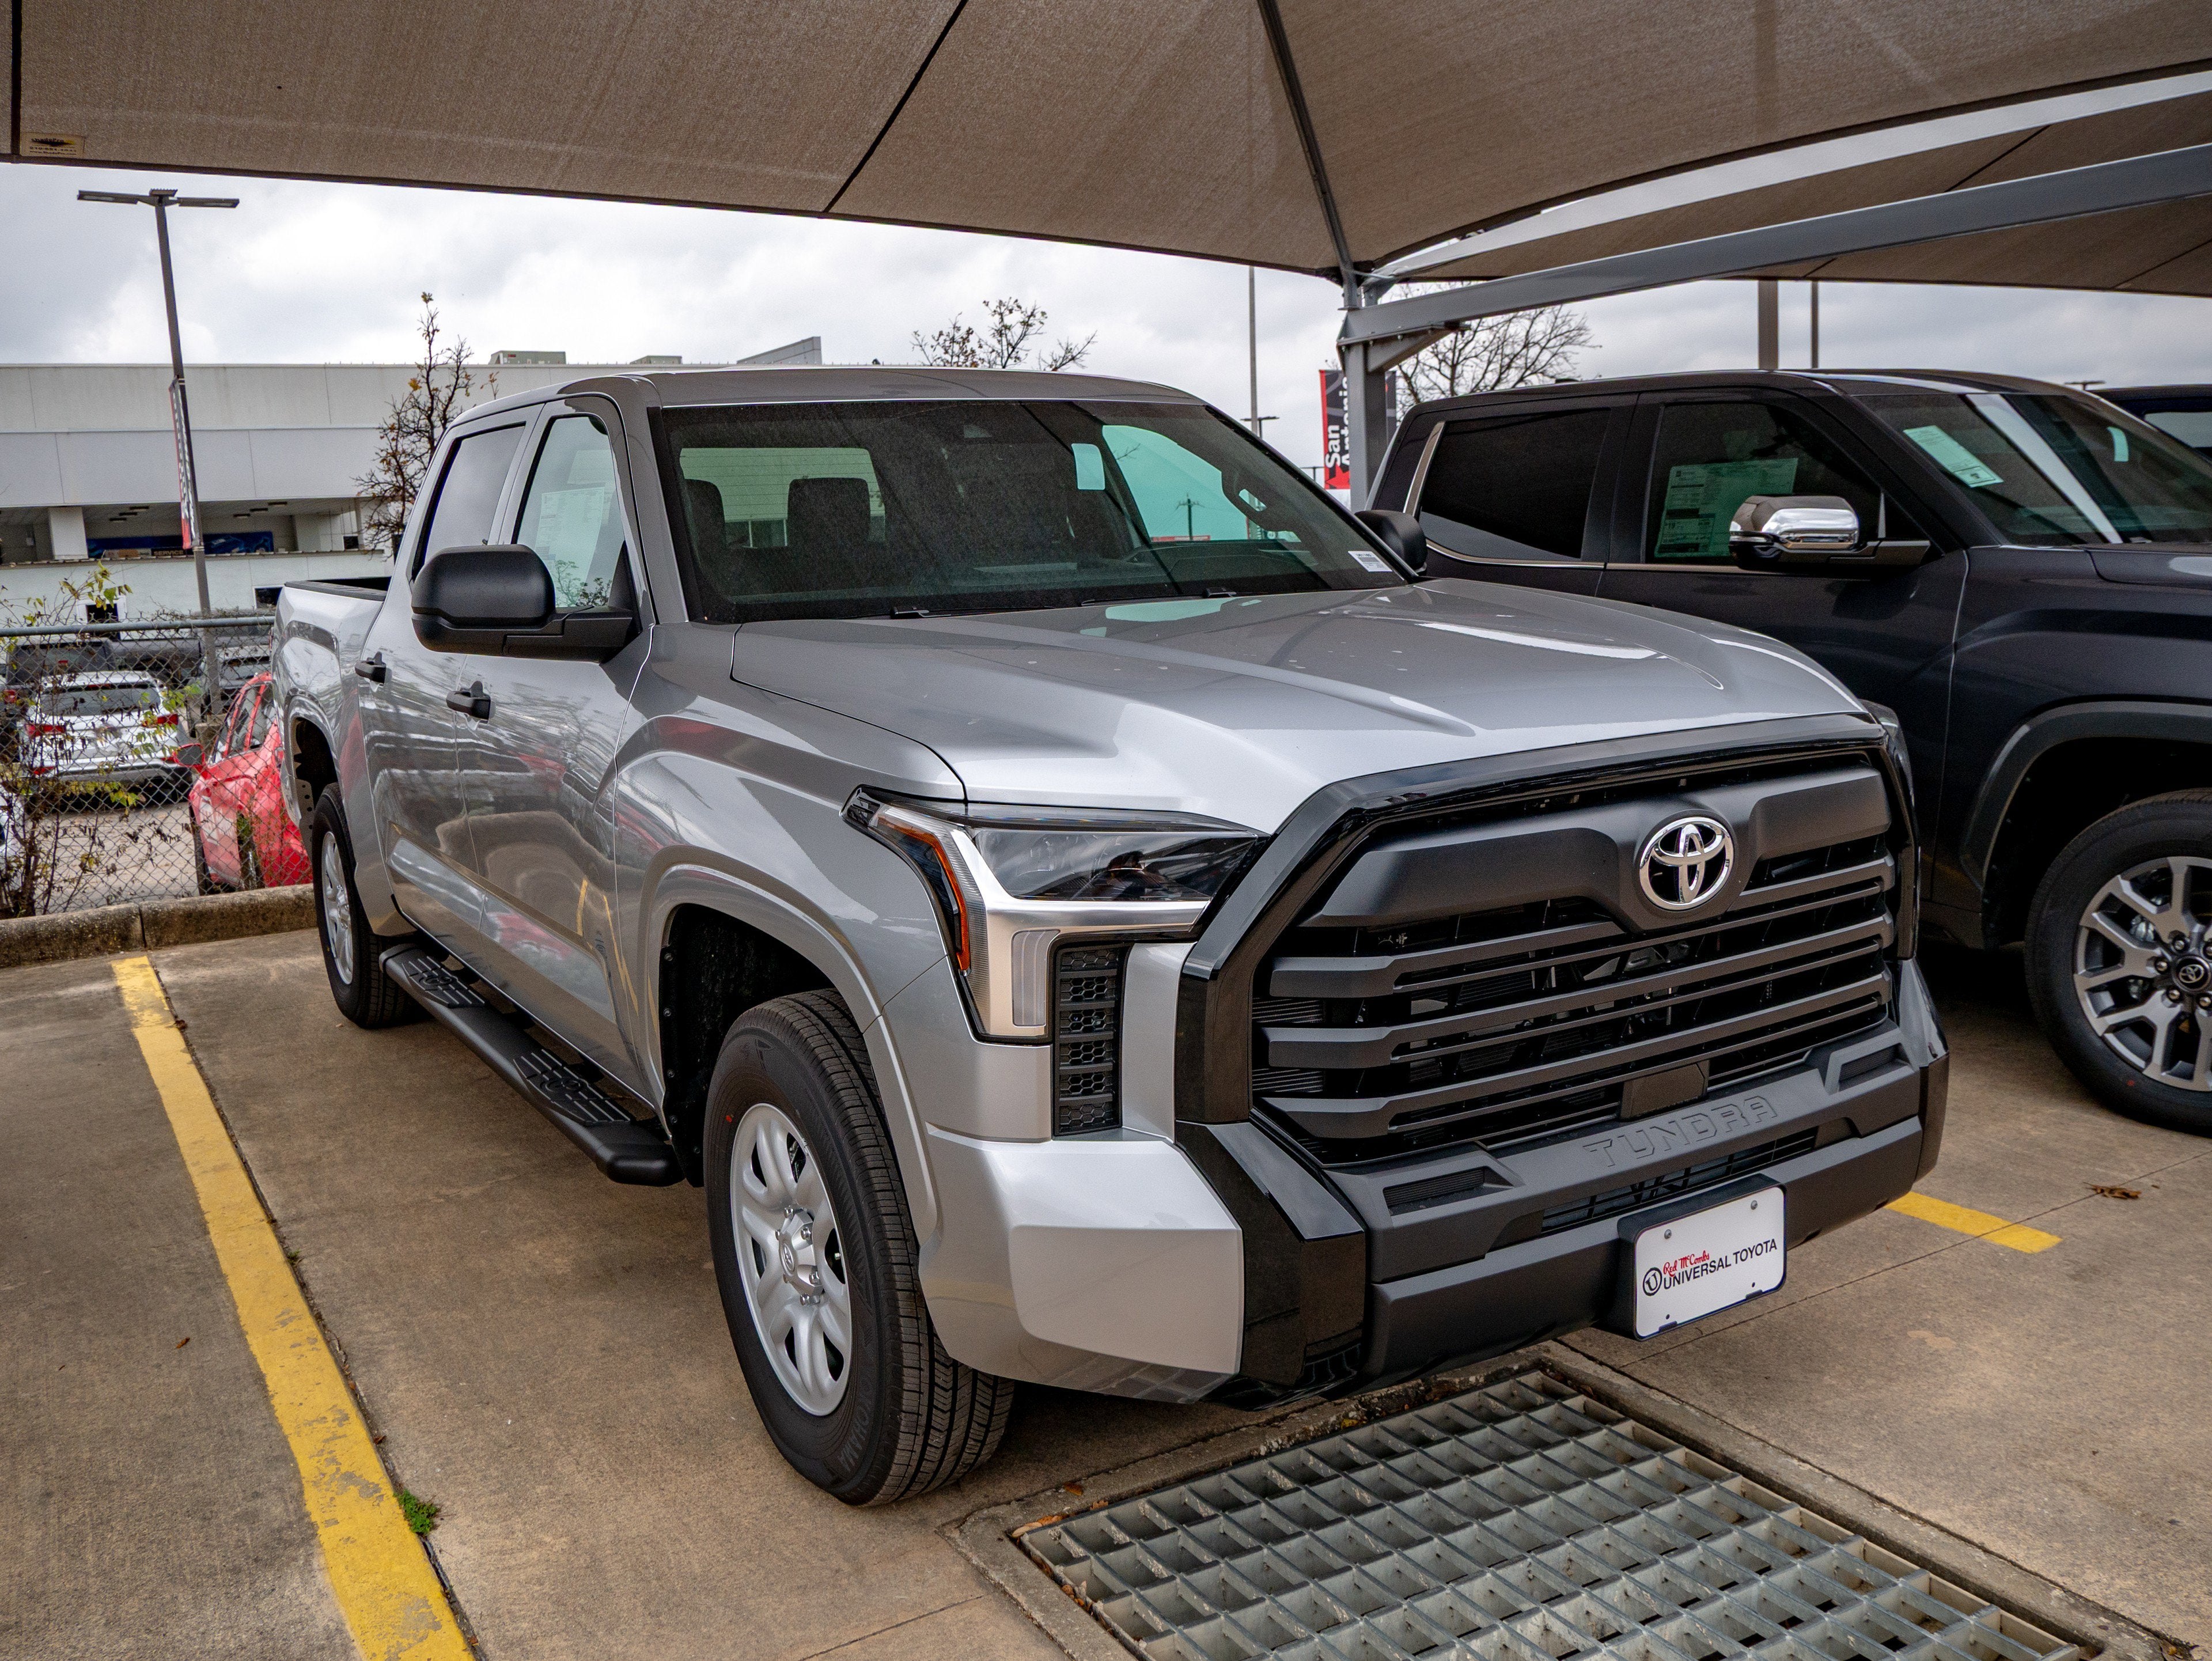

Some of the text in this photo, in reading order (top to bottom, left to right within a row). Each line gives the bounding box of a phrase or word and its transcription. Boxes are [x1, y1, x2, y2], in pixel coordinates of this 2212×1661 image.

[1325, 425, 1340, 468] San
[1582, 1095, 1778, 1167] TUNDRA
[1663, 1250, 1710, 1277] Red McCombs
[1664, 1255, 1732, 1289] UNIVERSAL
[1733, 1238, 1777, 1264] TOYOTA
